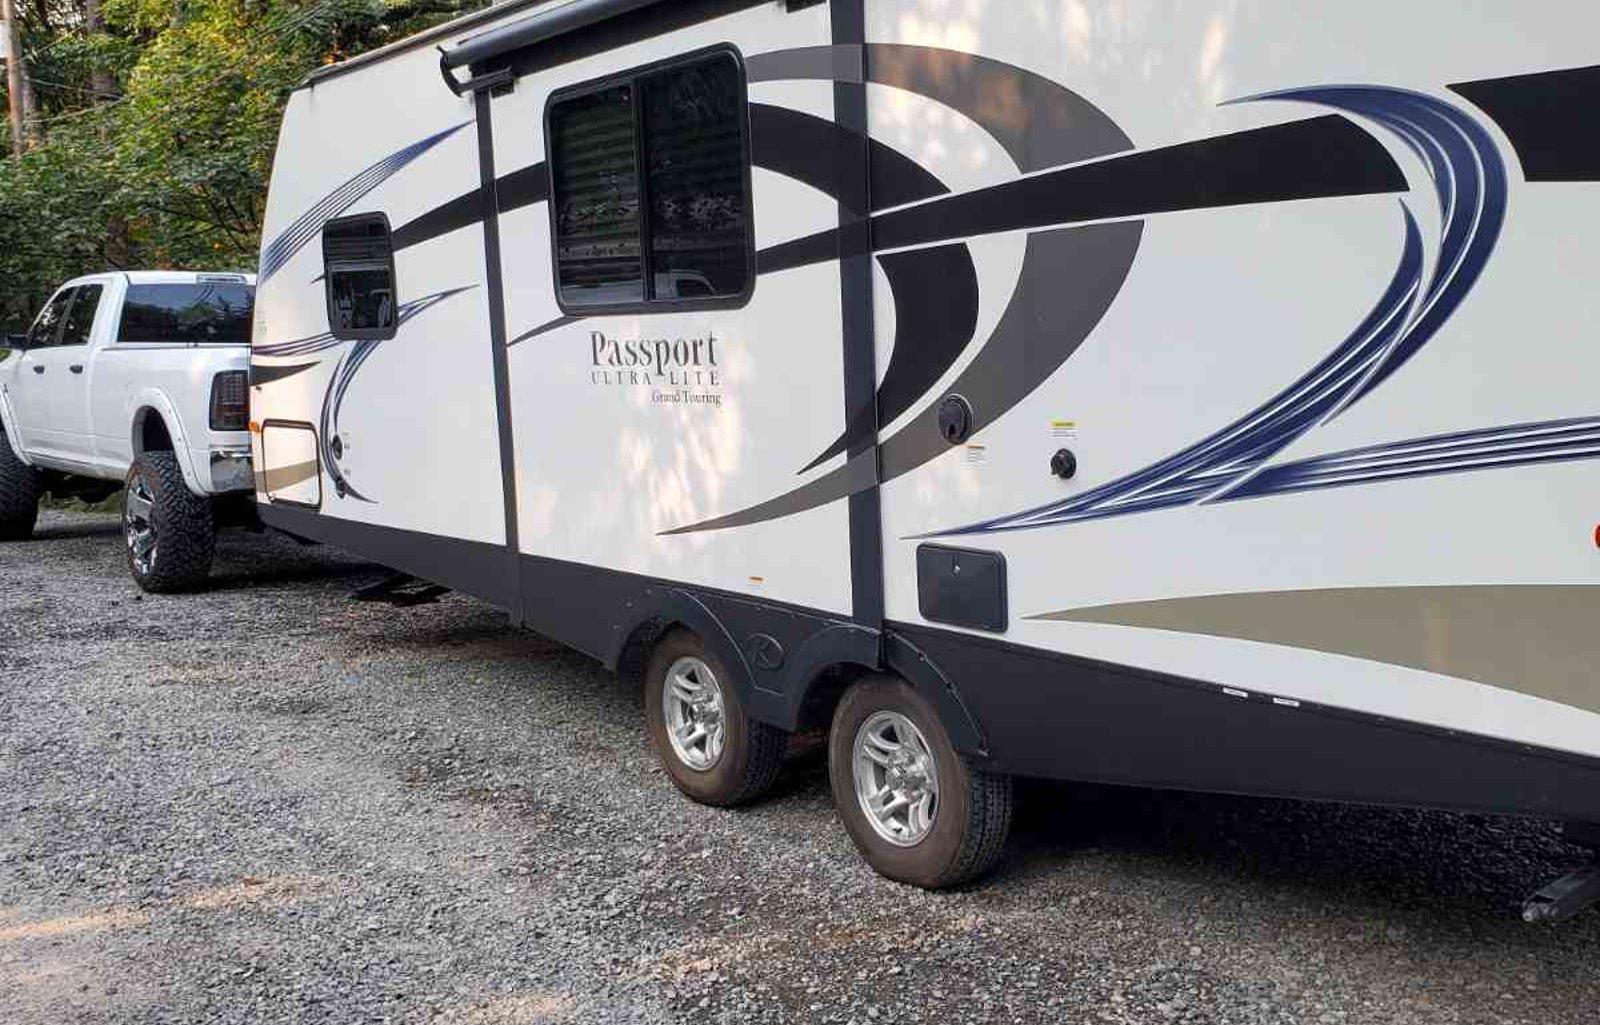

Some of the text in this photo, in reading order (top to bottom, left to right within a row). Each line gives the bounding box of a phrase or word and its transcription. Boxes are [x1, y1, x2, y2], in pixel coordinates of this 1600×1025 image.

[589, 330, 719, 376] Passport
[591, 370, 720, 385] ULTRA LITE
[652, 389, 721, 408] Grand Touring
